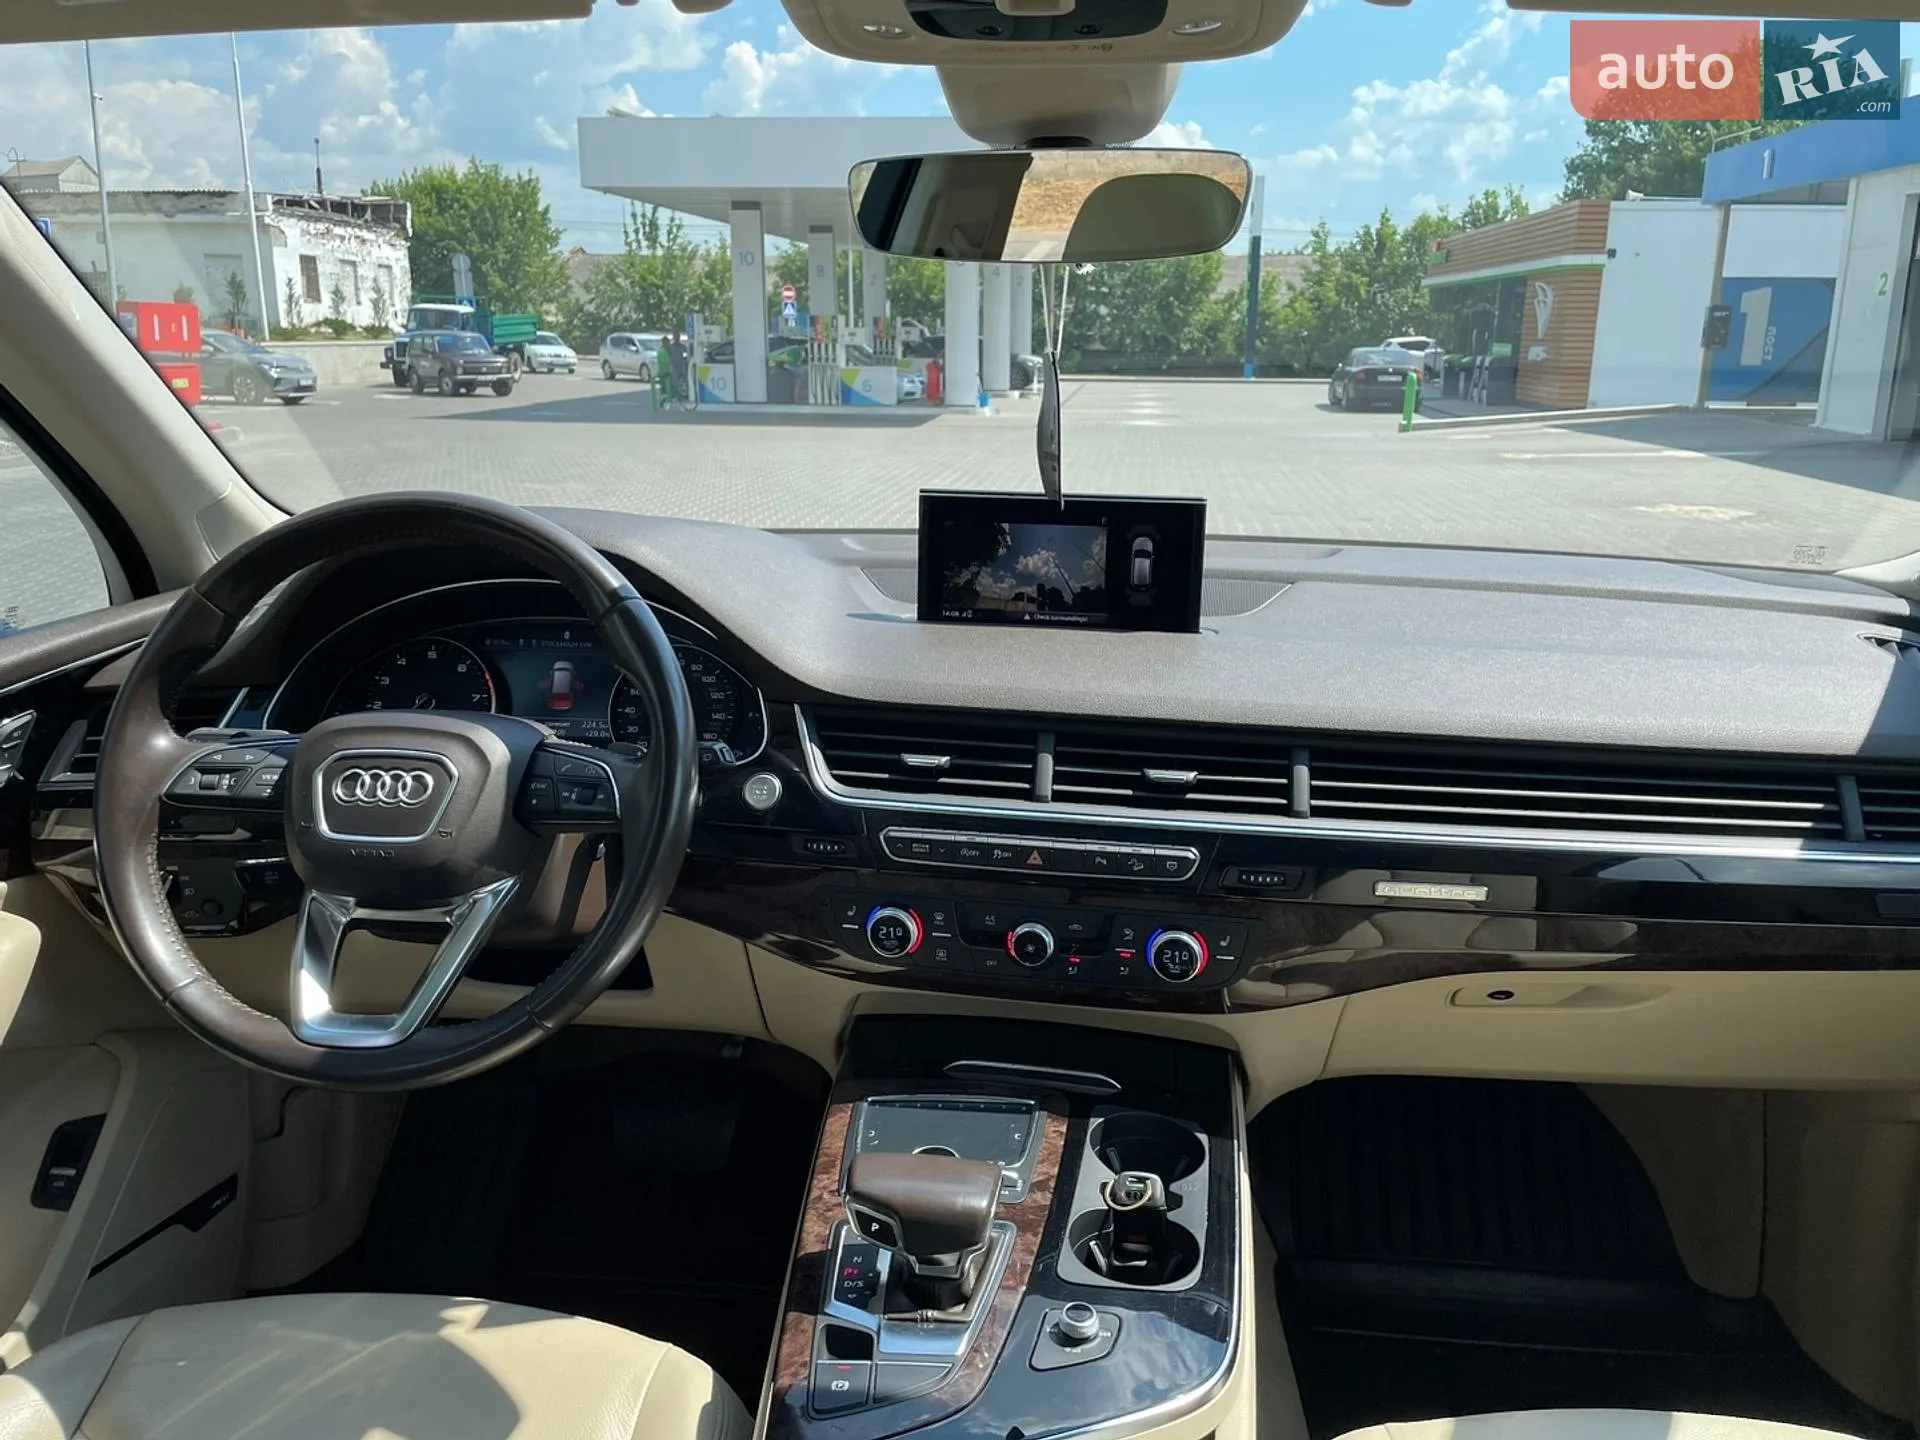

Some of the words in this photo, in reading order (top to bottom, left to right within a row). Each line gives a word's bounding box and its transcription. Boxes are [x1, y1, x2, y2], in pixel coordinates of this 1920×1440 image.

[1763, 149, 1775, 180] 1
[739, 251, 755, 266] 10
[816, 265, 825, 277] 8
[1878, 271, 1889, 297] 2
[1740, 286, 1772, 366] 1
[711, 377, 727, 392] 10
[862, 378, 873, 393] 6
[428, 651, 437, 659] 5
[380, 677, 390, 685] 3
[472, 694, 481, 702] 7
[372, 701, 382, 709] 2
[872, 1222, 883, 1232] P
[853, 1256, 863, 1264] N
